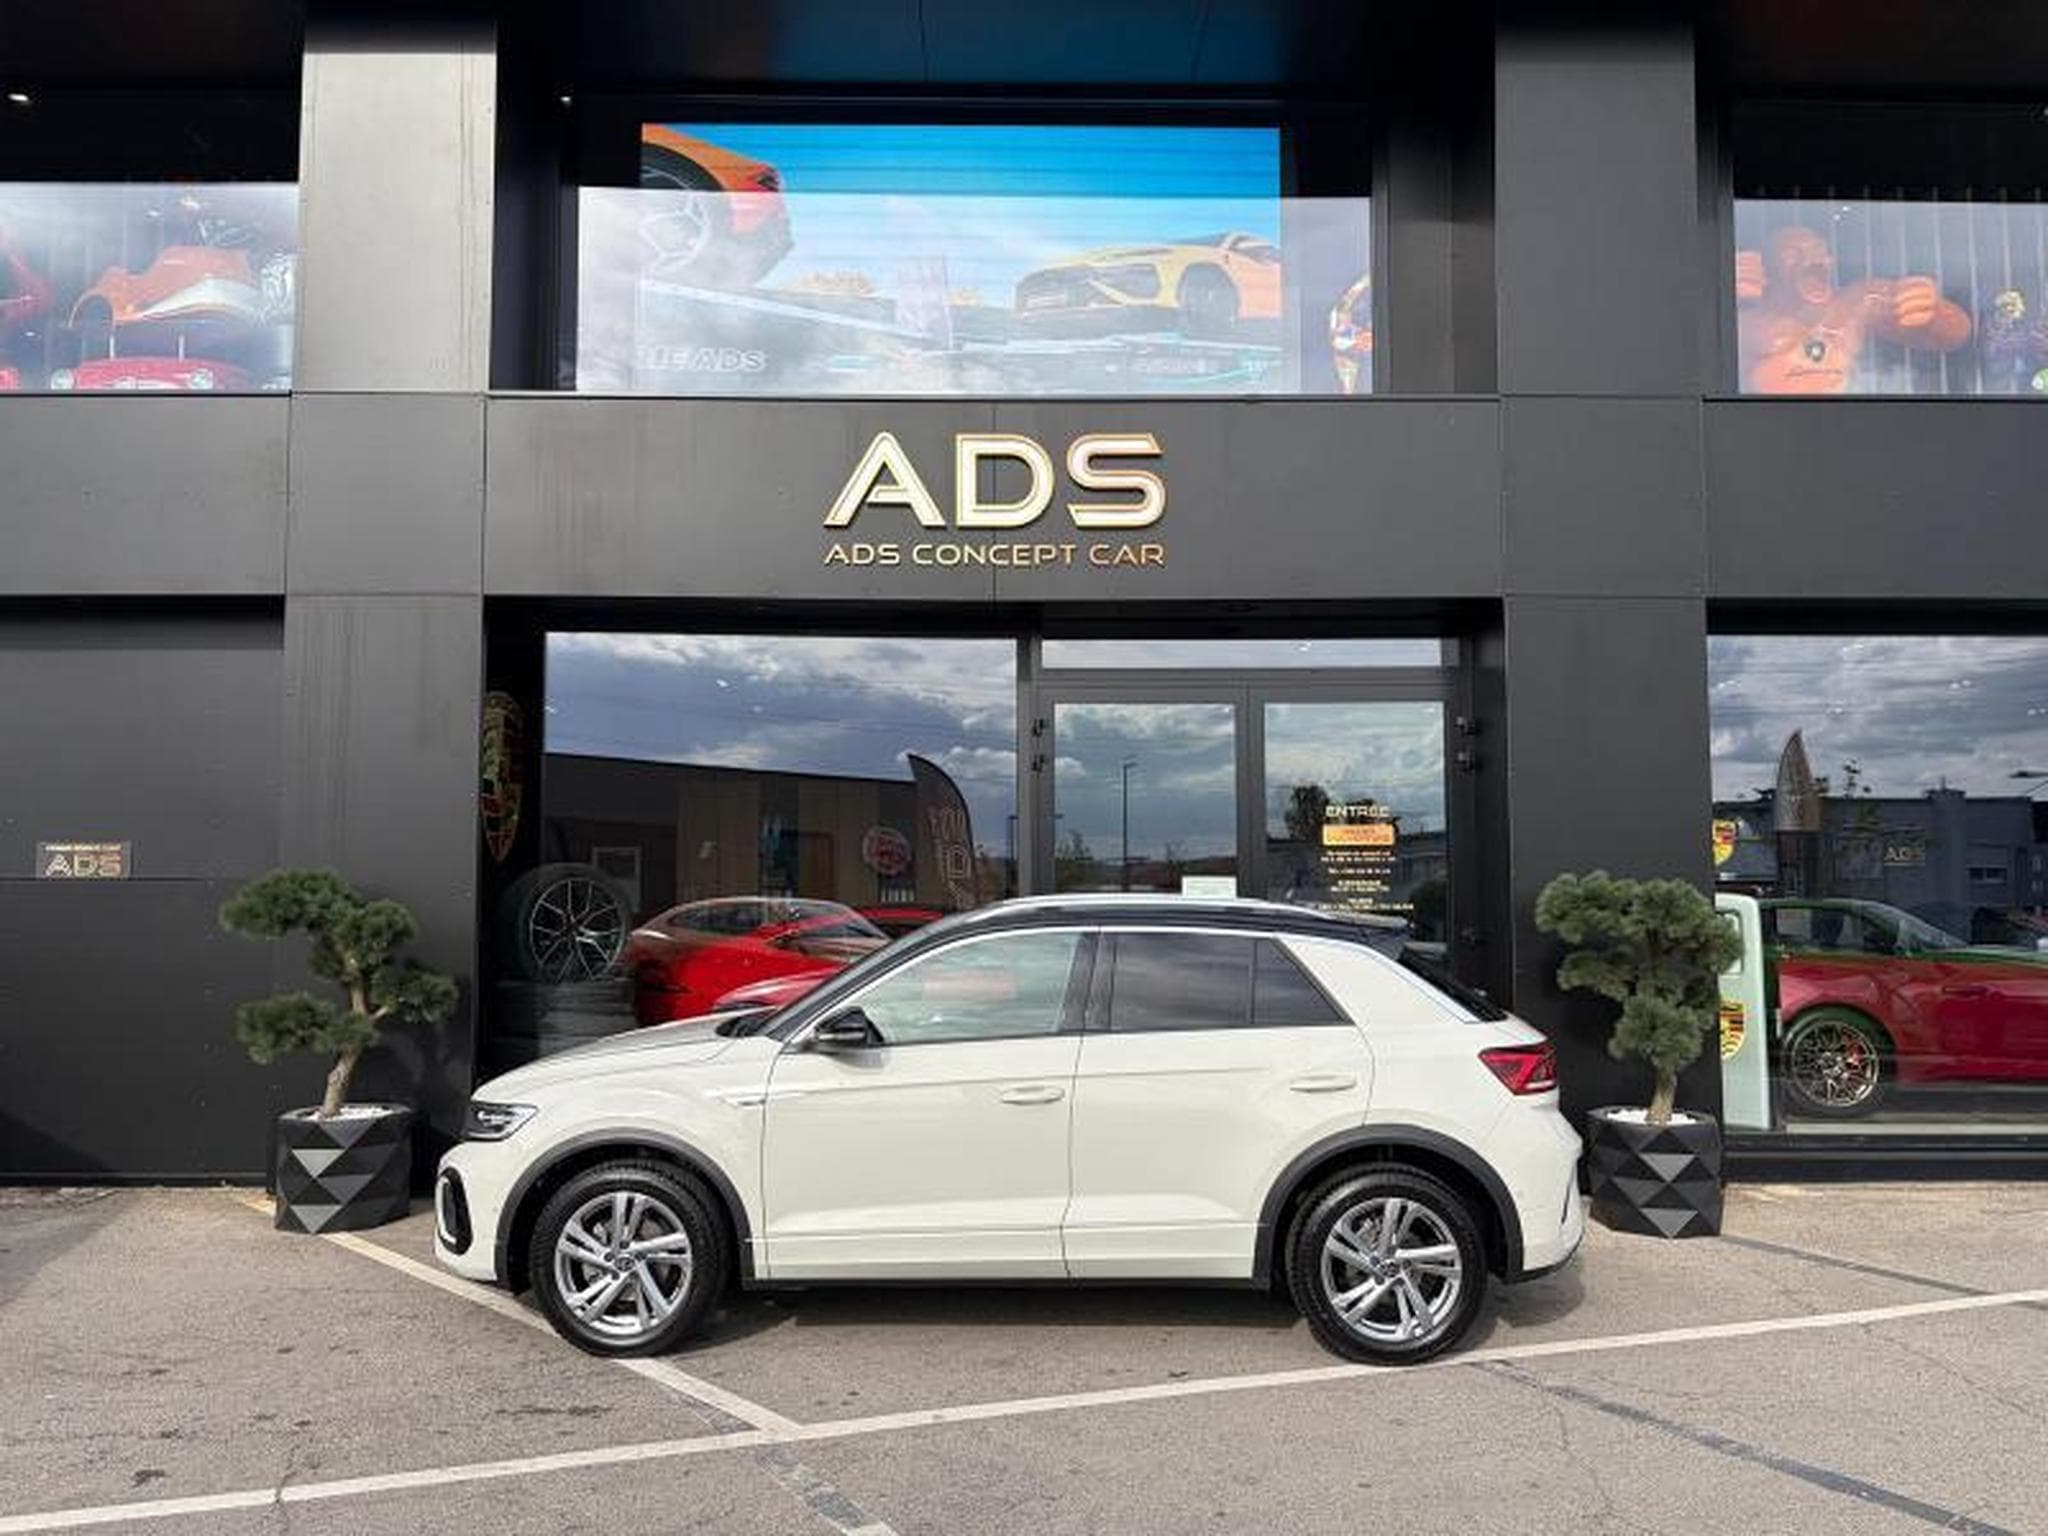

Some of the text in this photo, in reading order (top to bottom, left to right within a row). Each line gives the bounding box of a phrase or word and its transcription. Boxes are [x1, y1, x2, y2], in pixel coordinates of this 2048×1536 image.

[823, 431, 1166, 528] ADS
[824, 543, 1166, 567] ADS CONCEPT CAR
[45, 854, 122, 877] ADS
